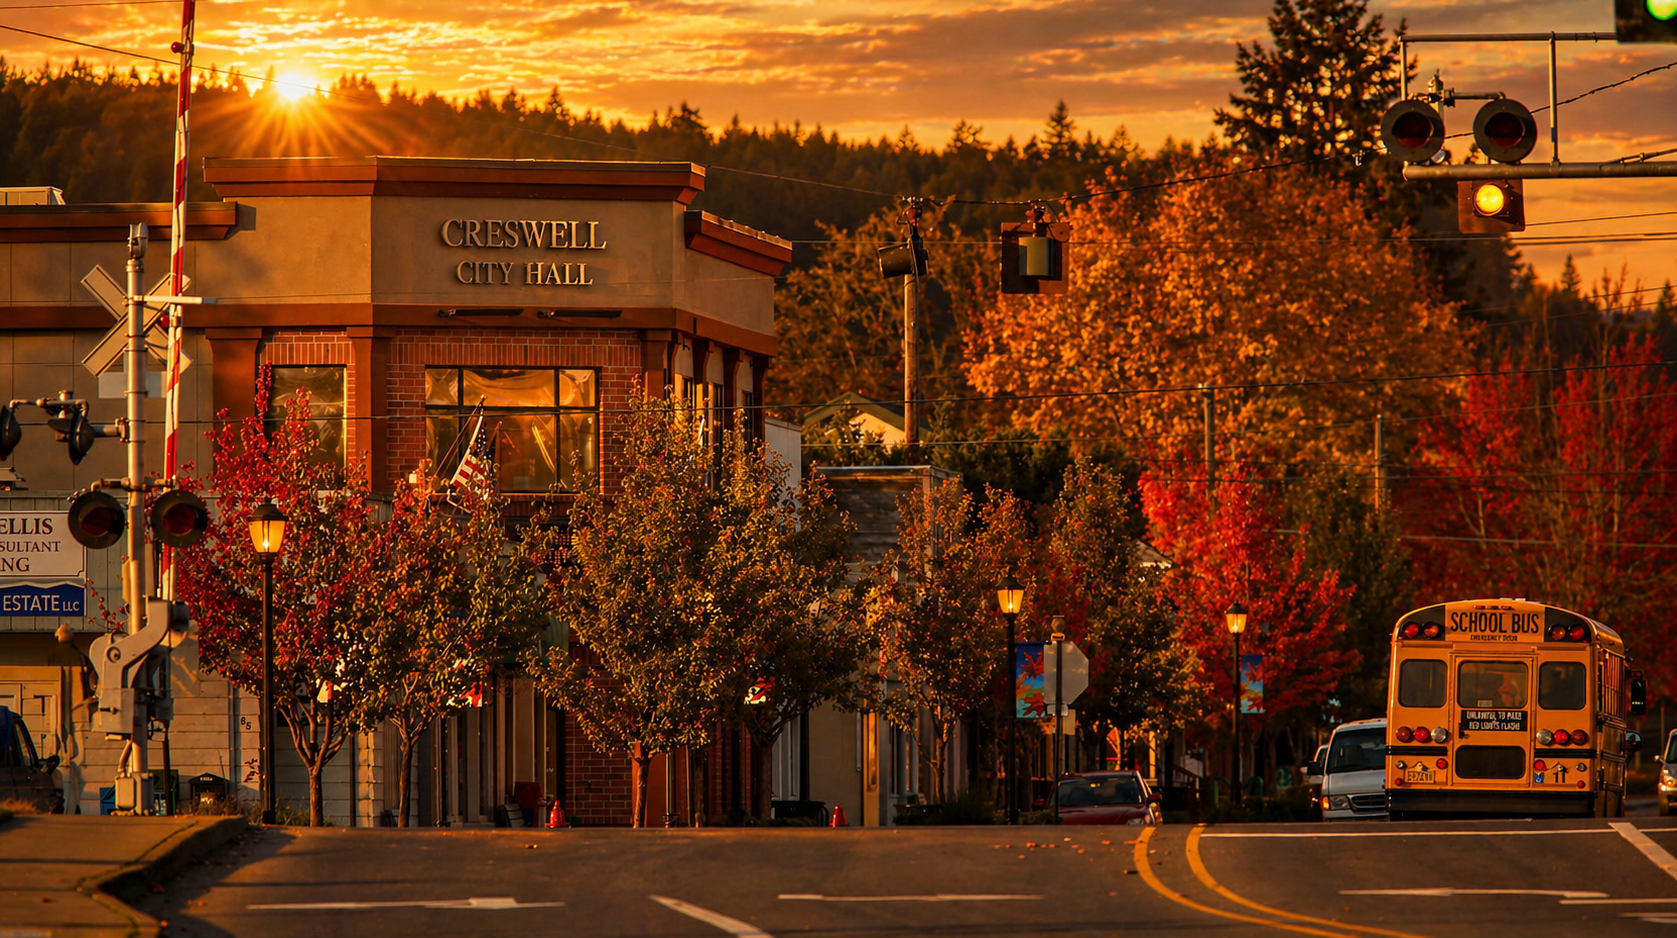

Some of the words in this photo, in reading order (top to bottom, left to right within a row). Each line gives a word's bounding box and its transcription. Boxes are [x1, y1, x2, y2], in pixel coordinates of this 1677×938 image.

[441, 219, 607, 249] CRESWELL
[456, 260, 514, 285] CITY
[525, 262, 593, 286] HALL
[3, 595, 60, 611] ESTATE
[62, 601, 80, 612] LLC
[1450, 612, 1507, 633] SCHOOL
[1511, 613, 1539, 634] BUS
